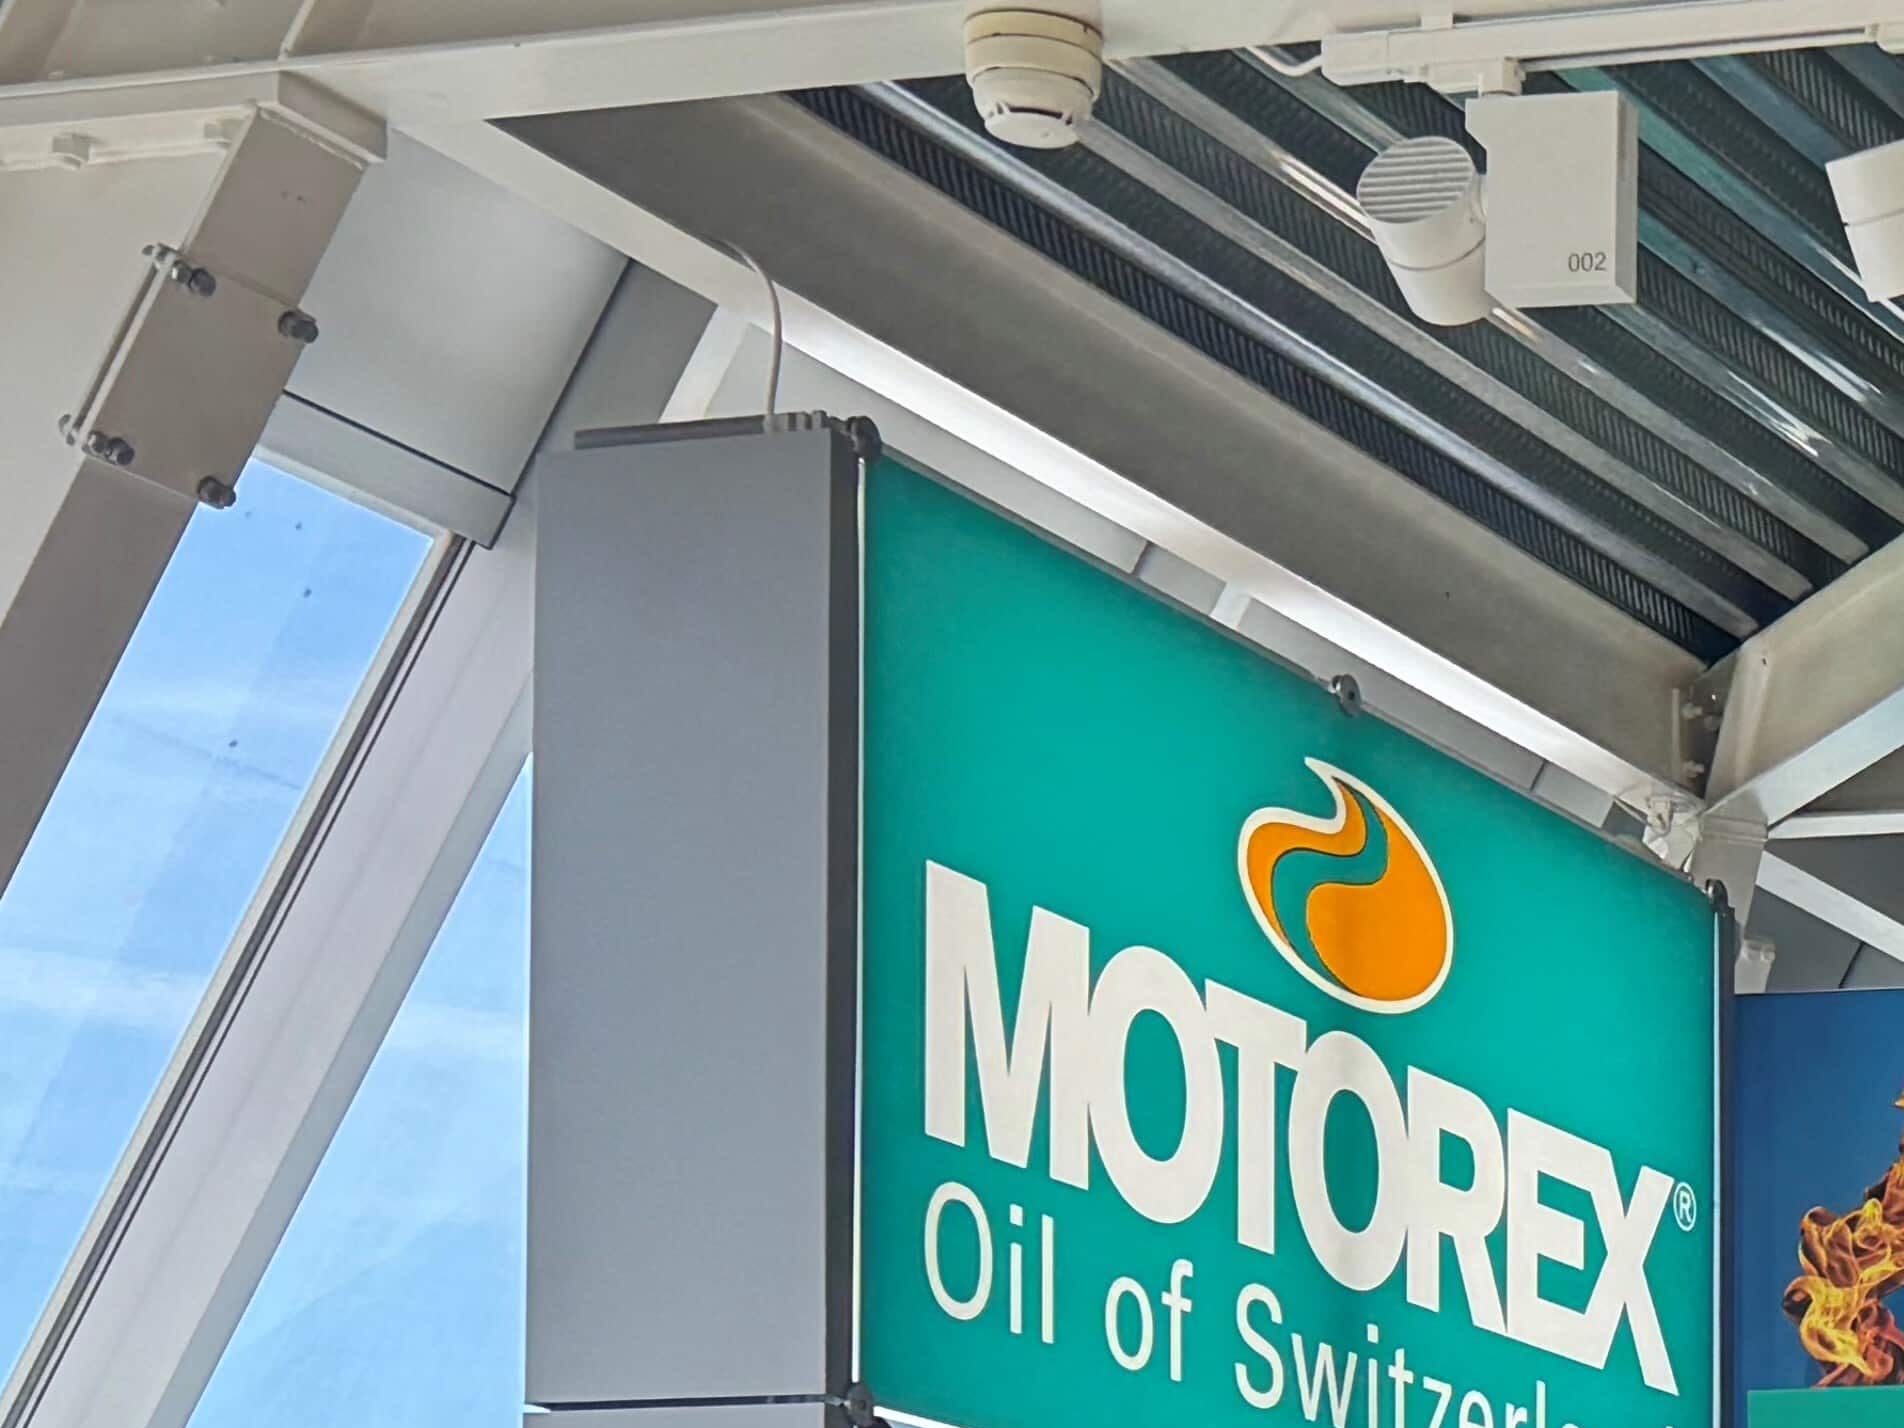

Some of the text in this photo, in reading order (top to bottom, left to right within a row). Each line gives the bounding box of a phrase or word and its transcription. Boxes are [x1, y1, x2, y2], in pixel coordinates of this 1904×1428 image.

[1567, 251, 1606, 273] 002
[924, 1181, 1054, 1345] Oil
[1105, 1259, 1194, 1382] of
